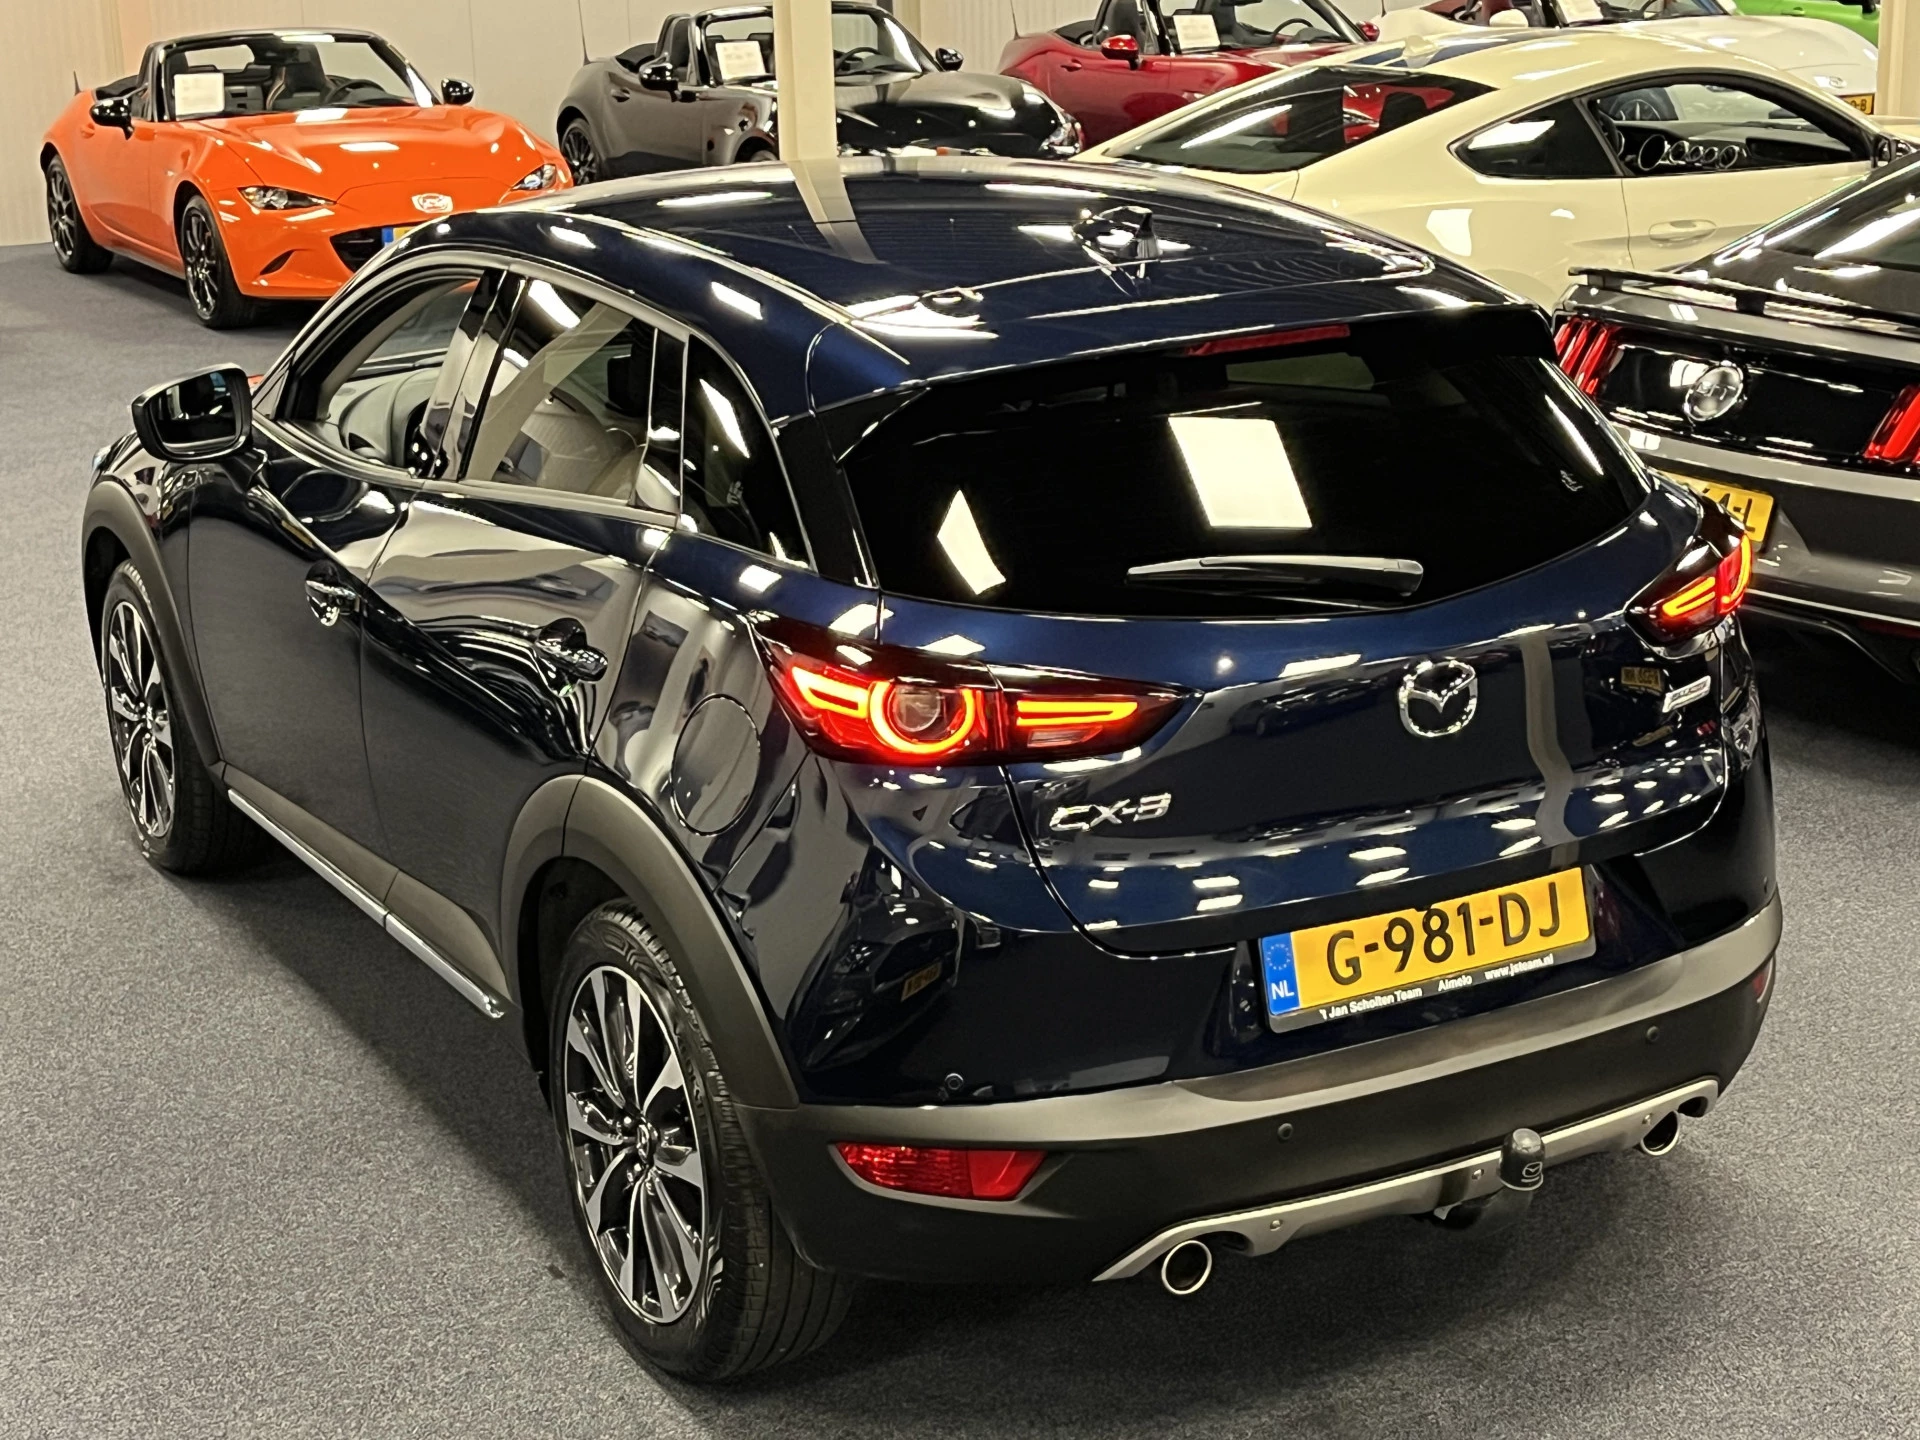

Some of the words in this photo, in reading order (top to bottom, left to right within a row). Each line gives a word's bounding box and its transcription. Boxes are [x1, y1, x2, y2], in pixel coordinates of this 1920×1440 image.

[1049, 792, 1172, 832] CX-3
[1326, 881, 1562, 987] G-981-DJ
[1271, 980, 1295, 1000] NL
[1328, 1005, 1348, 1018] Jan
[1349, 994, 1395, 1013] Scholten
[1393, 987, 1423, 1002] Team
[1438, 975, 1473, 992] Almelo
[1484, 953, 1554, 980] www.jsteam.nl
